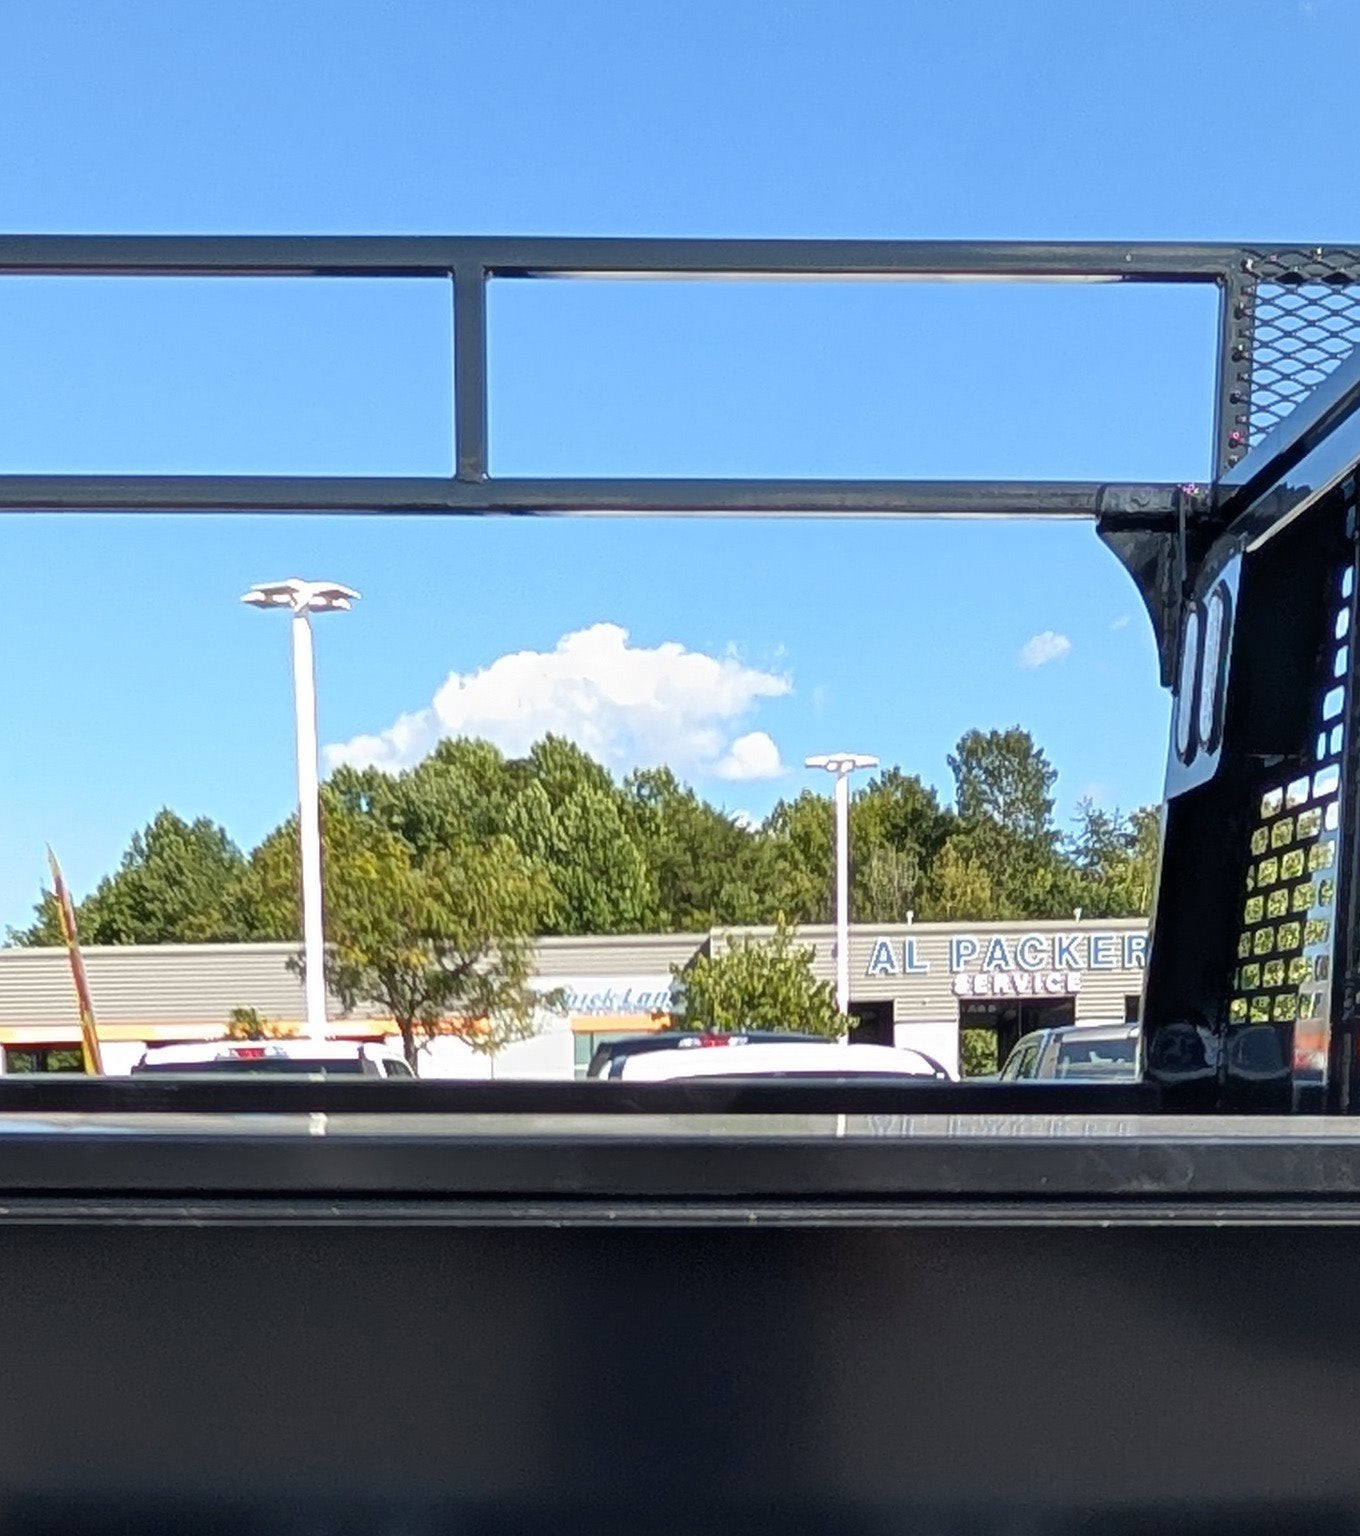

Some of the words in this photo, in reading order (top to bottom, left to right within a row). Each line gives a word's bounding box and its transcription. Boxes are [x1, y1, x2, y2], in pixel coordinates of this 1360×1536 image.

[868, 935, 930, 974] AL
[951, 931, 1150, 972] PACKER
[952, 972, 1082, 995] SERVICE
